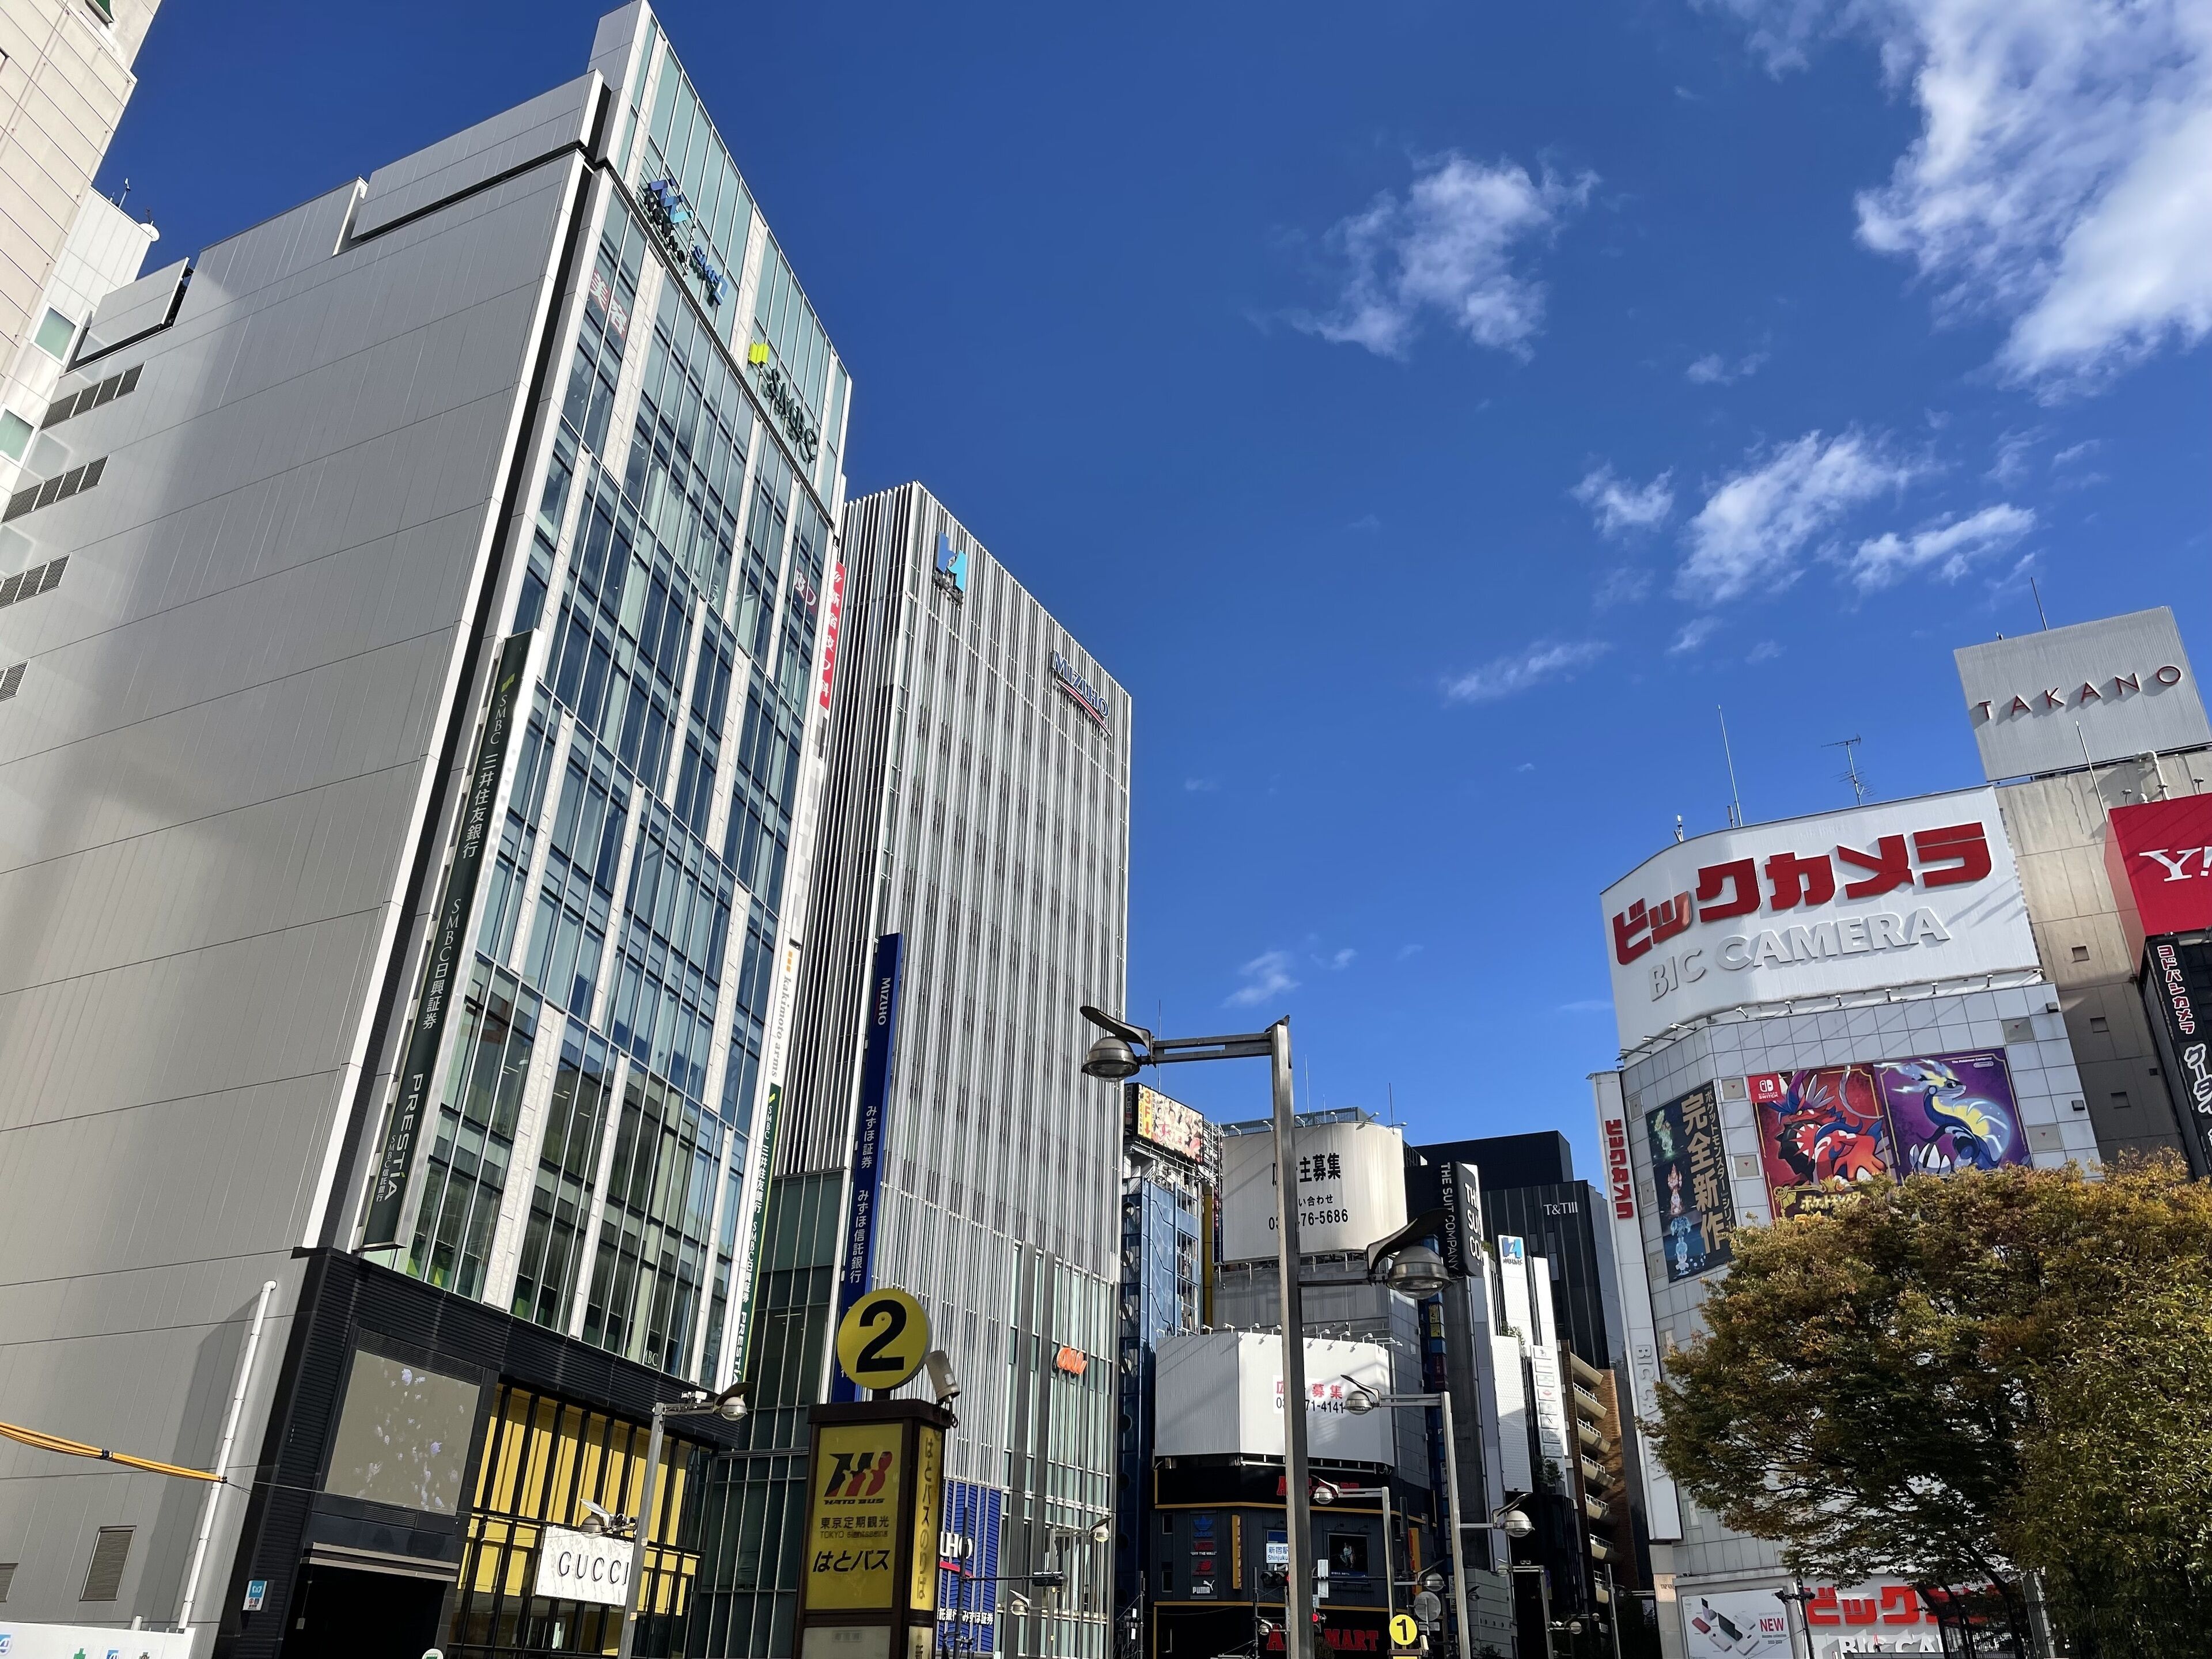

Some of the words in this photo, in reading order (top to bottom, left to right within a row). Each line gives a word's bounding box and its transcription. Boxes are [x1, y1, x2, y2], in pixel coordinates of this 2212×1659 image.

[590, 272, 627, 335] 美容
[769, 368, 818, 461] SMBC
[1052, 649, 1109, 719] MIZUHO
[1978, 665, 2181, 720] TAKANO
[490, 694, 507, 744] SMBC
[463, 753, 499, 859] 三井住友銀行
[1612, 821, 1991, 965] ビックカメラ
[1648, 948, 1705, 1002] BIC
[1717, 907, 1950, 971] CAMERA
[777, 975, 792, 1039] kakimoto
[877, 977, 891, 1025] MIZUHO
[2157, 945, 2195, 1035] ヨドバシカメラ
[771, 1043, 782, 1078] arms
[764, 1105, 773, 1140] SMBC
[861, 1105, 877, 1168] みずほ証券
[1440, 1162, 1452, 1185] THE
[1605, 1119, 1634, 1219] ビックカメラ
[1681, 1092, 1728, 1254] 完全新作
[1442, 1187, 1455, 1213] SUIT
[850, 1190, 869, 1283] みずほ信託銀行
[1445, 1215, 1460, 1272] COMPANY
[856, 1300, 907, 1373] 2
[1635, 1344, 1654, 1381] BIC
[820, 1515, 889, 1529] 東京定期観光
[820, 1530, 844, 1539] TOKYO
[917, 1437, 933, 1599] はとバスのりば
[558, 1550, 630, 1586] GUCCI
[813, 1550, 891, 1573] はとバス
[962, 1610, 994, 1625] みずほ証券
[1396, 1619, 1407, 1641] 1
[1760, 1618, 1783, 1632] NEW
